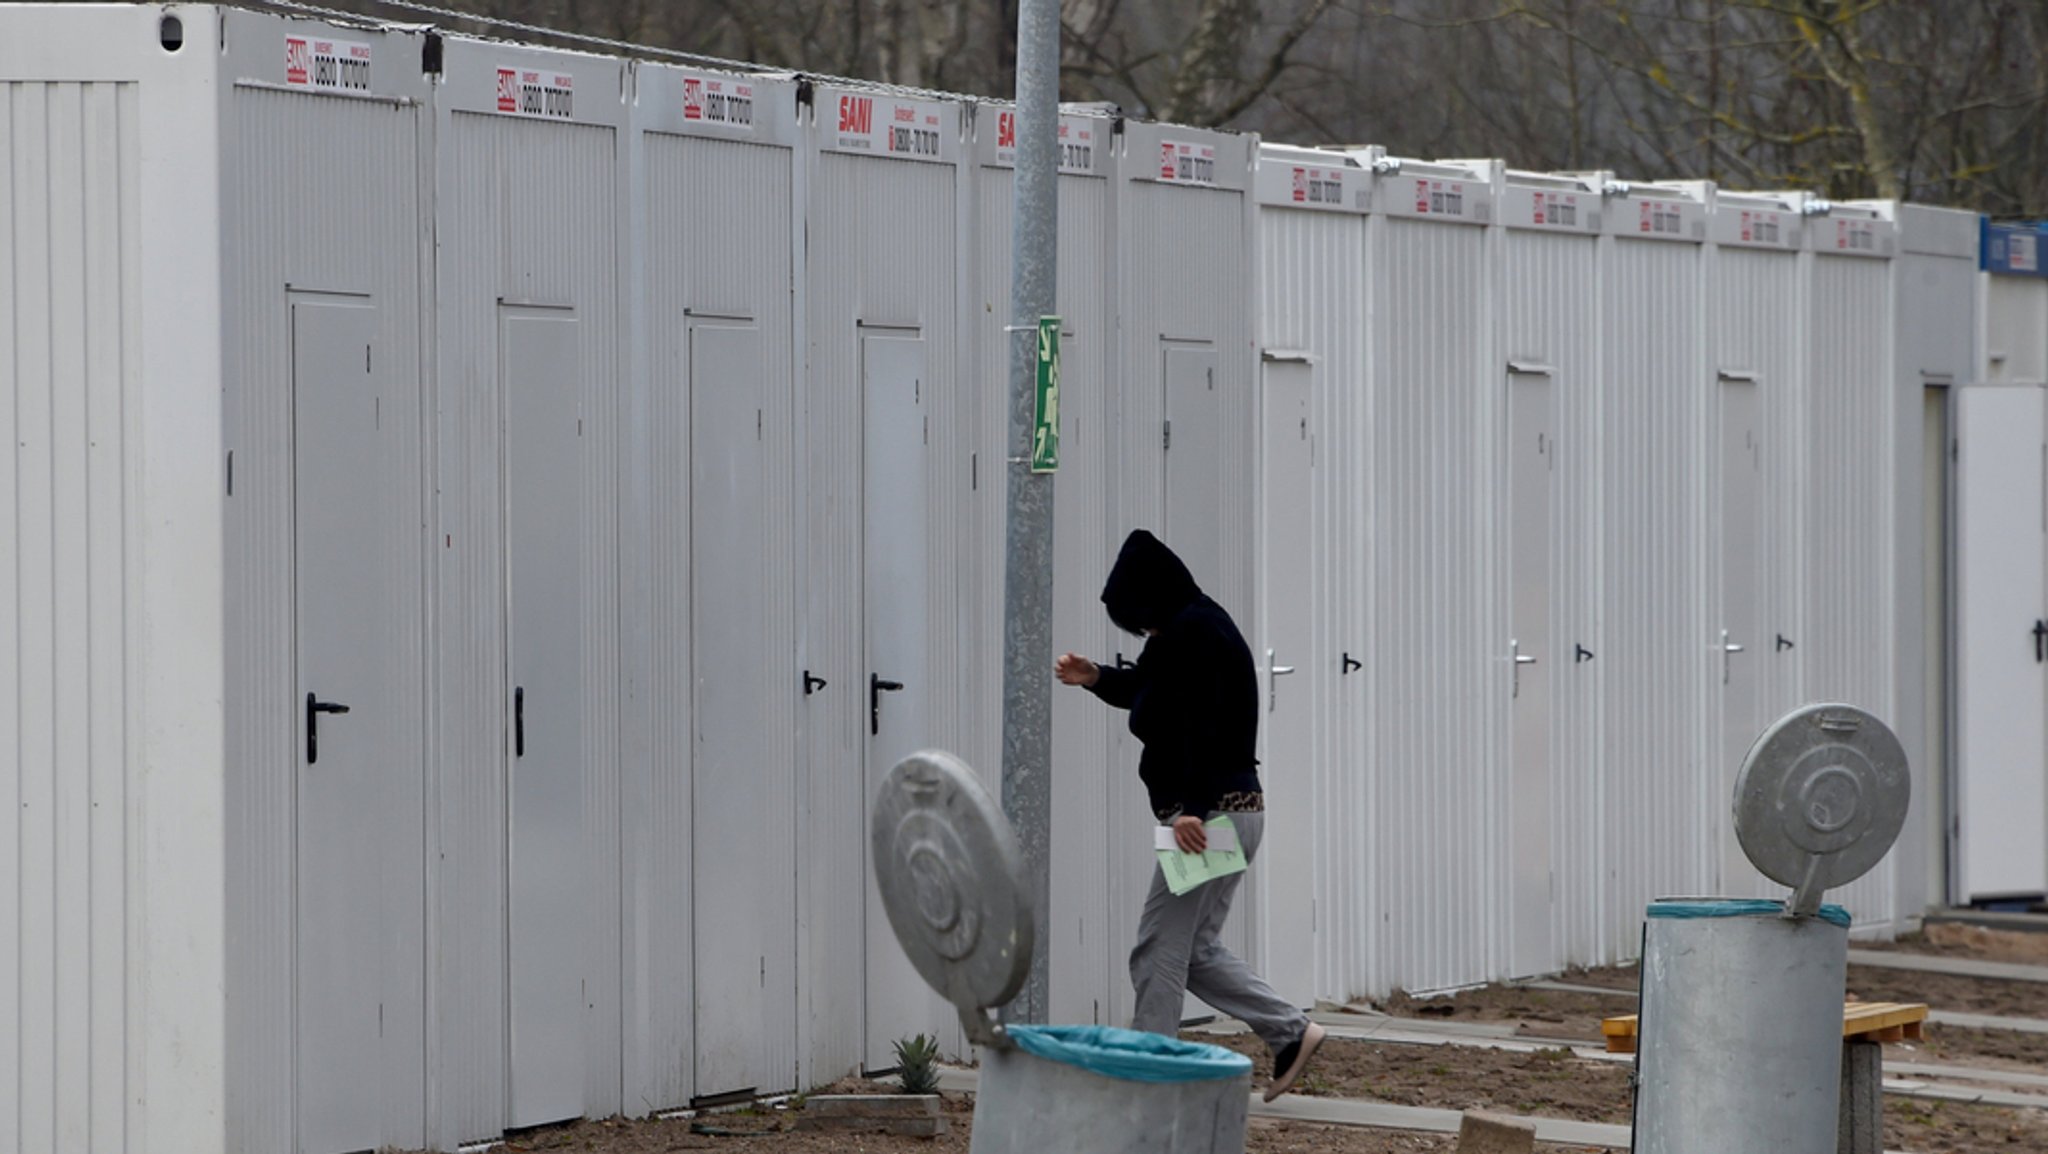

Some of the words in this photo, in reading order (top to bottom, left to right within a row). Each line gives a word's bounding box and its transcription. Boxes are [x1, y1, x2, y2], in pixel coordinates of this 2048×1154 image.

[315, 55, 337, 87] 0800
[523, 84, 542, 114] 0800
[707, 93, 725, 121] 0800
[839, 96, 872, 134] SANI
[998, 112, 1014, 148] SA
